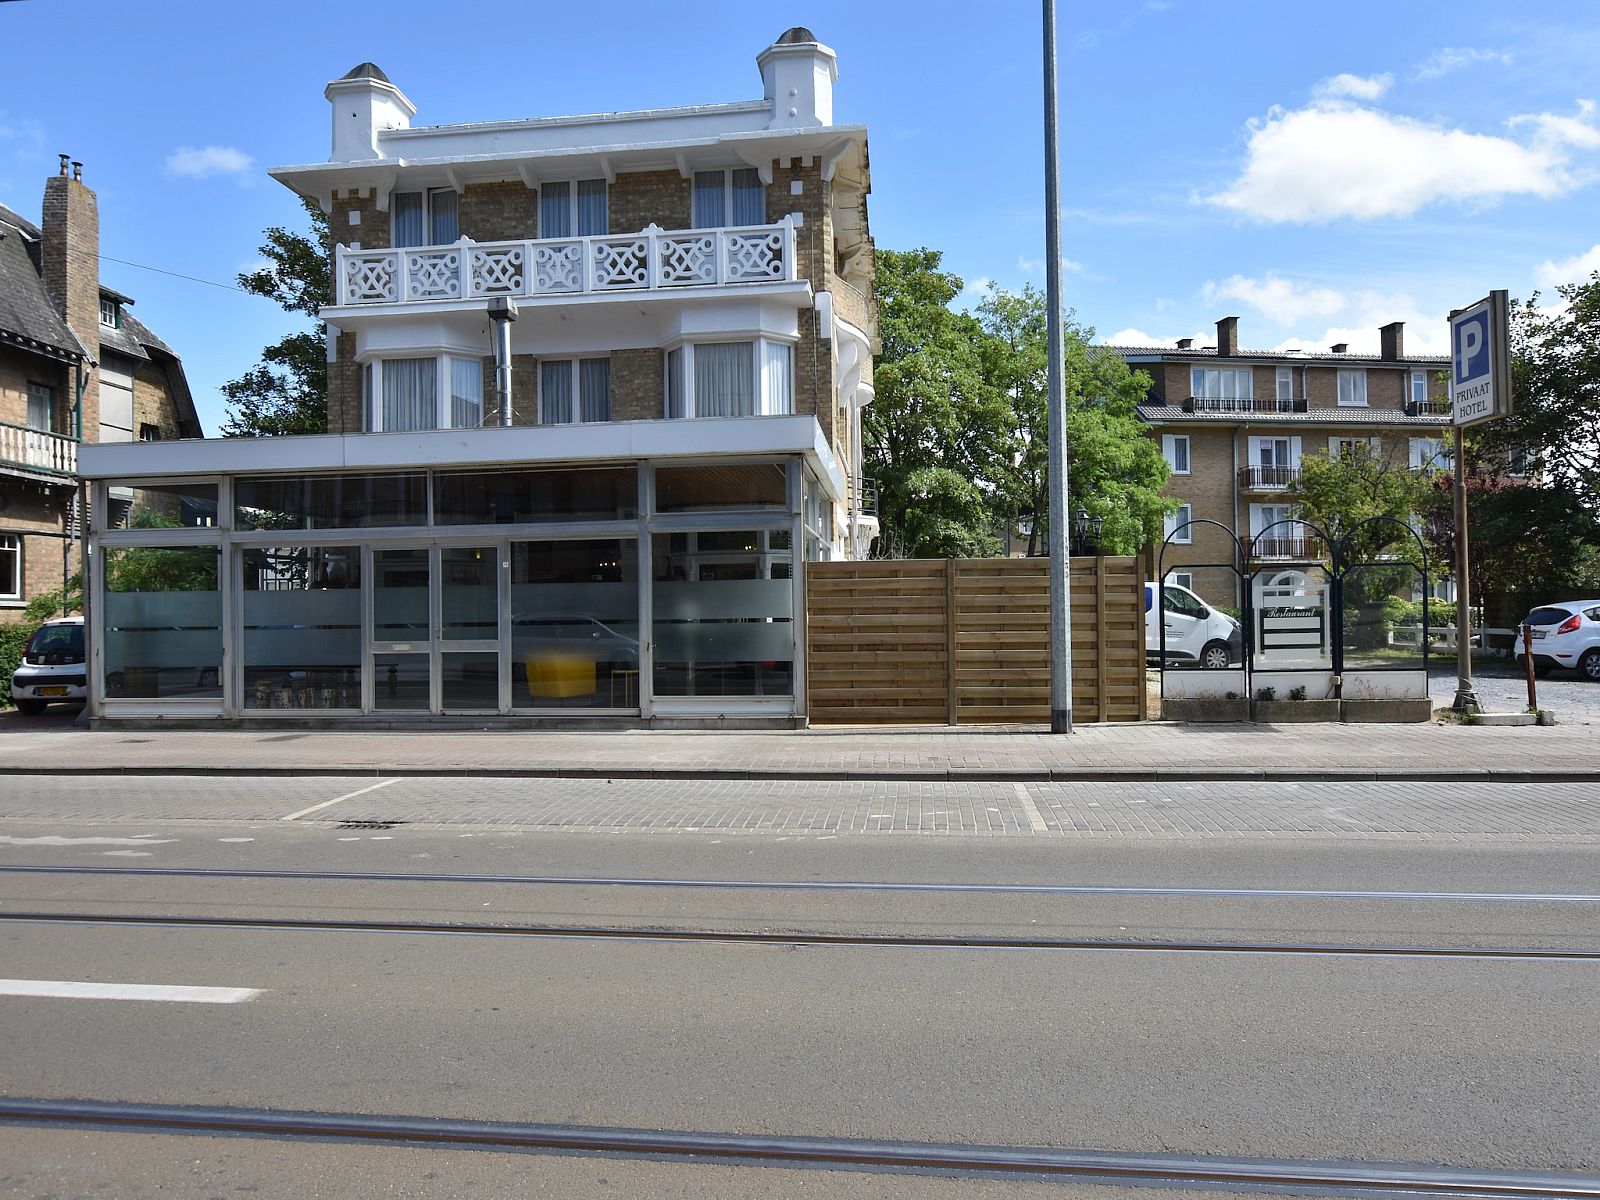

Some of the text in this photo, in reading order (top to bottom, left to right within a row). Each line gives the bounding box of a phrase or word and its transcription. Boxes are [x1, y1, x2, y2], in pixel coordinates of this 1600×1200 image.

[1460, 320, 1482, 378] P
[1456, 382, 1490, 403] PRIVAAT
[1460, 400, 1487, 418] HOTEL
[1267, 608, 1316, 618] Restaurant
